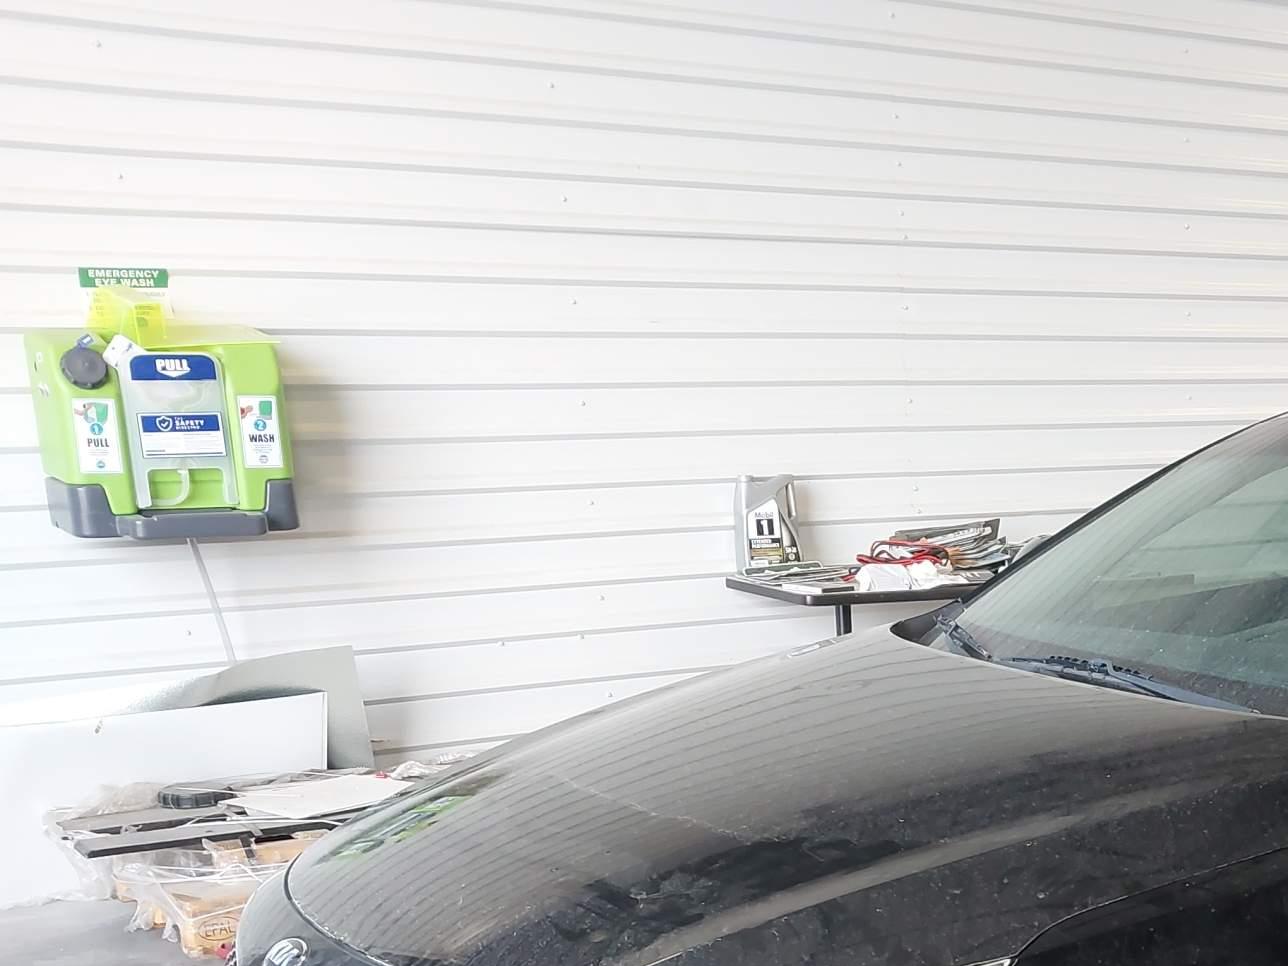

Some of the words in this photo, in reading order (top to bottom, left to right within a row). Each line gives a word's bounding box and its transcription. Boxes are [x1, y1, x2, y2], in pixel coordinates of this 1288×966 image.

[87, 269, 159, 278] EMERGENCY
[119, 278, 155, 287] WASH
[155, 358, 191, 371] PULL
[87, 437, 110, 448] PULL
[248, 434, 275, 443] WASH
